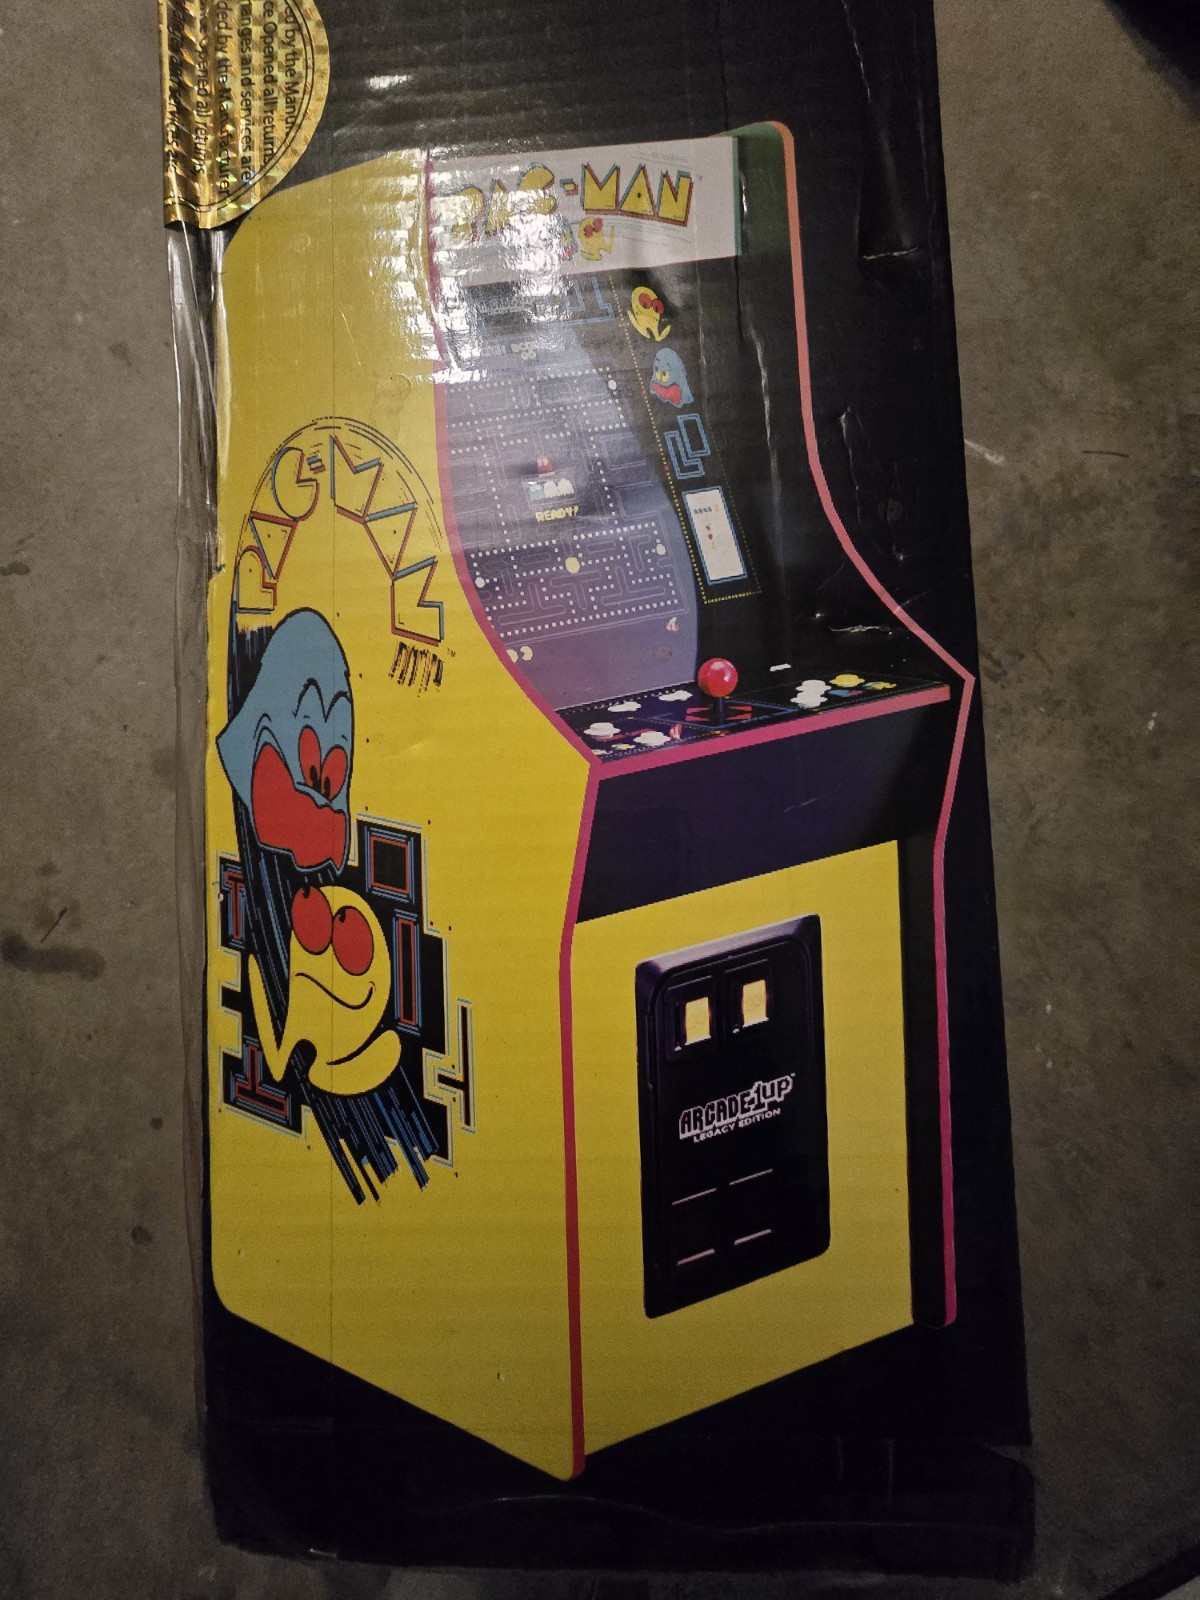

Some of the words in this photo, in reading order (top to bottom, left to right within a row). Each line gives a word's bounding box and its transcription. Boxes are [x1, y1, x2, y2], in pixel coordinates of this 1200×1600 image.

[214, 35, 234, 52] by
[259, 21, 279, 84] Opened
[282, 29, 301, 47] by
[218, 58, 233, 83] the
[240, 55, 256, 87] and
[285, 51, 300, 78] the
[262, 88, 279, 106] all
[240, 90, 255, 152] services
[217, 87, 234, 197] Manufacturer
[240, 155, 253, 182] are
[446, 162, 694, 243] PAC-MAN
[535, 505, 579, 522] READY!
[235, 434, 444, 647] PAC-MAN
[693, 1121, 736, 1143] LEGACY
[738, 1107, 781, 1128] EDITION
